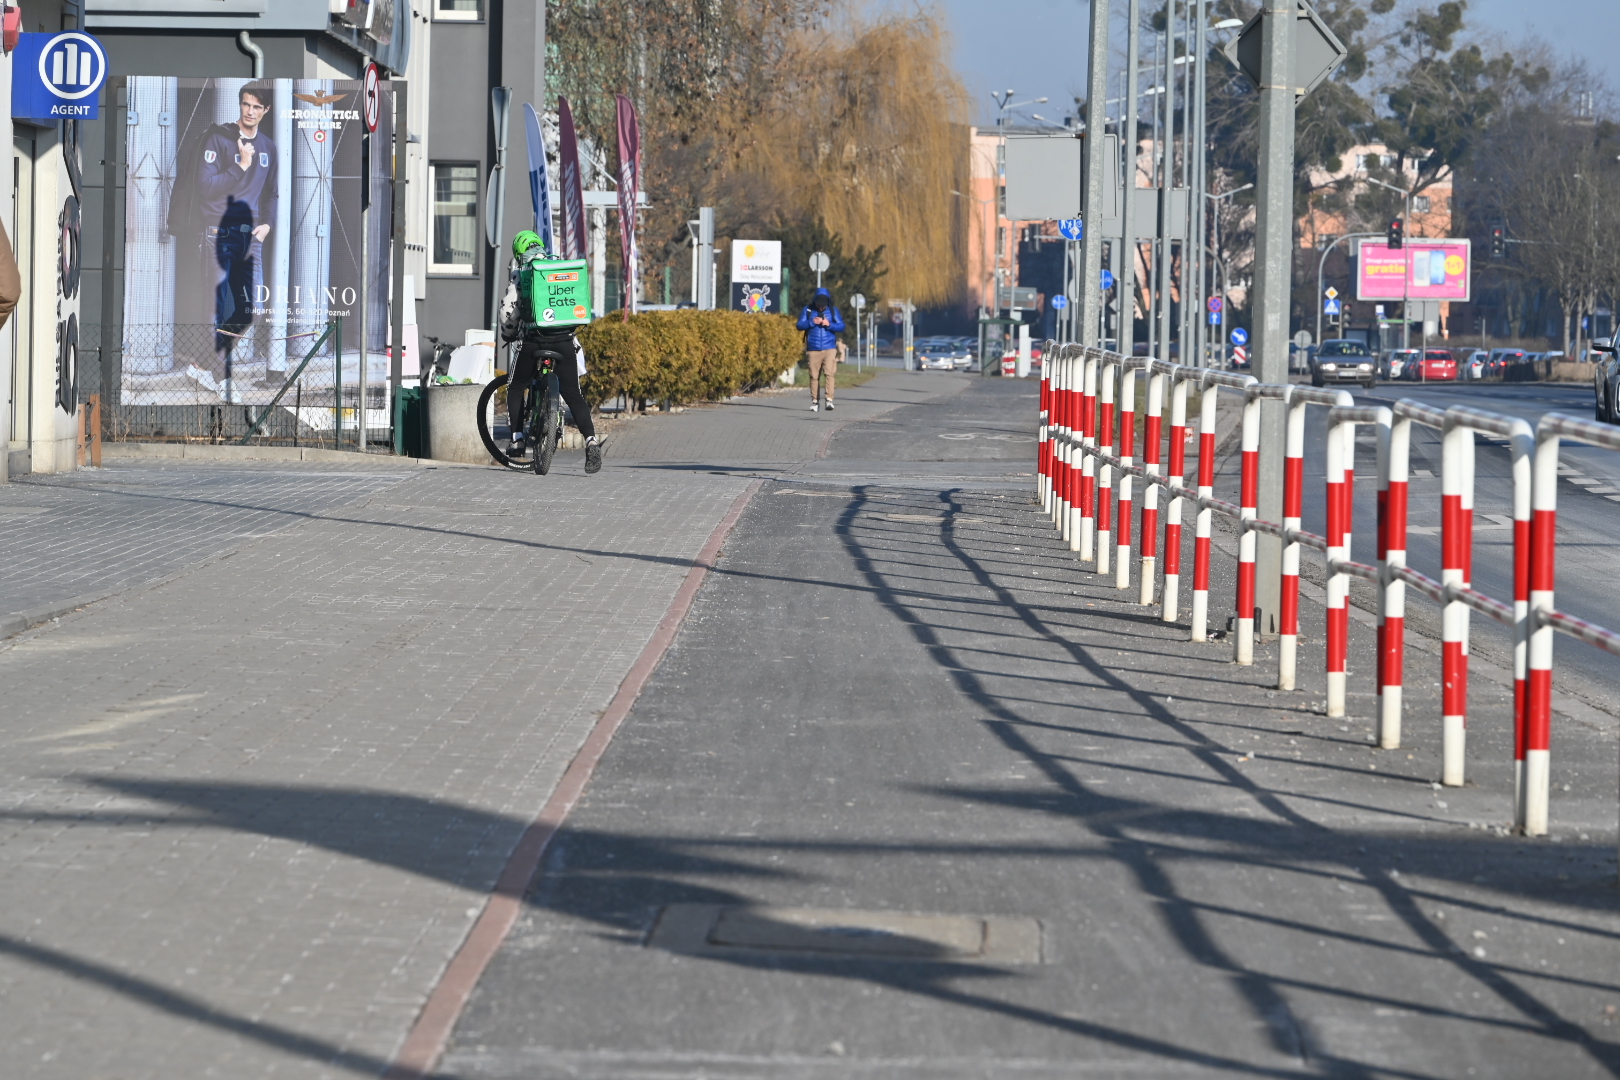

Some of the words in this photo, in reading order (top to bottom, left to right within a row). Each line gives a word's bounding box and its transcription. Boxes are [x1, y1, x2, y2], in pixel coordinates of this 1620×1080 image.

[50, 104, 90, 115] AGENT
[280, 110, 360, 120] AERONAUTICA
[298, 121, 342, 130] MILITARE
[1366, 263, 1406, 275] gratis
[548, 285, 575, 295] Uber
[240, 285, 356, 306] ADRIANO
[548, 297, 576, 307] Eats
